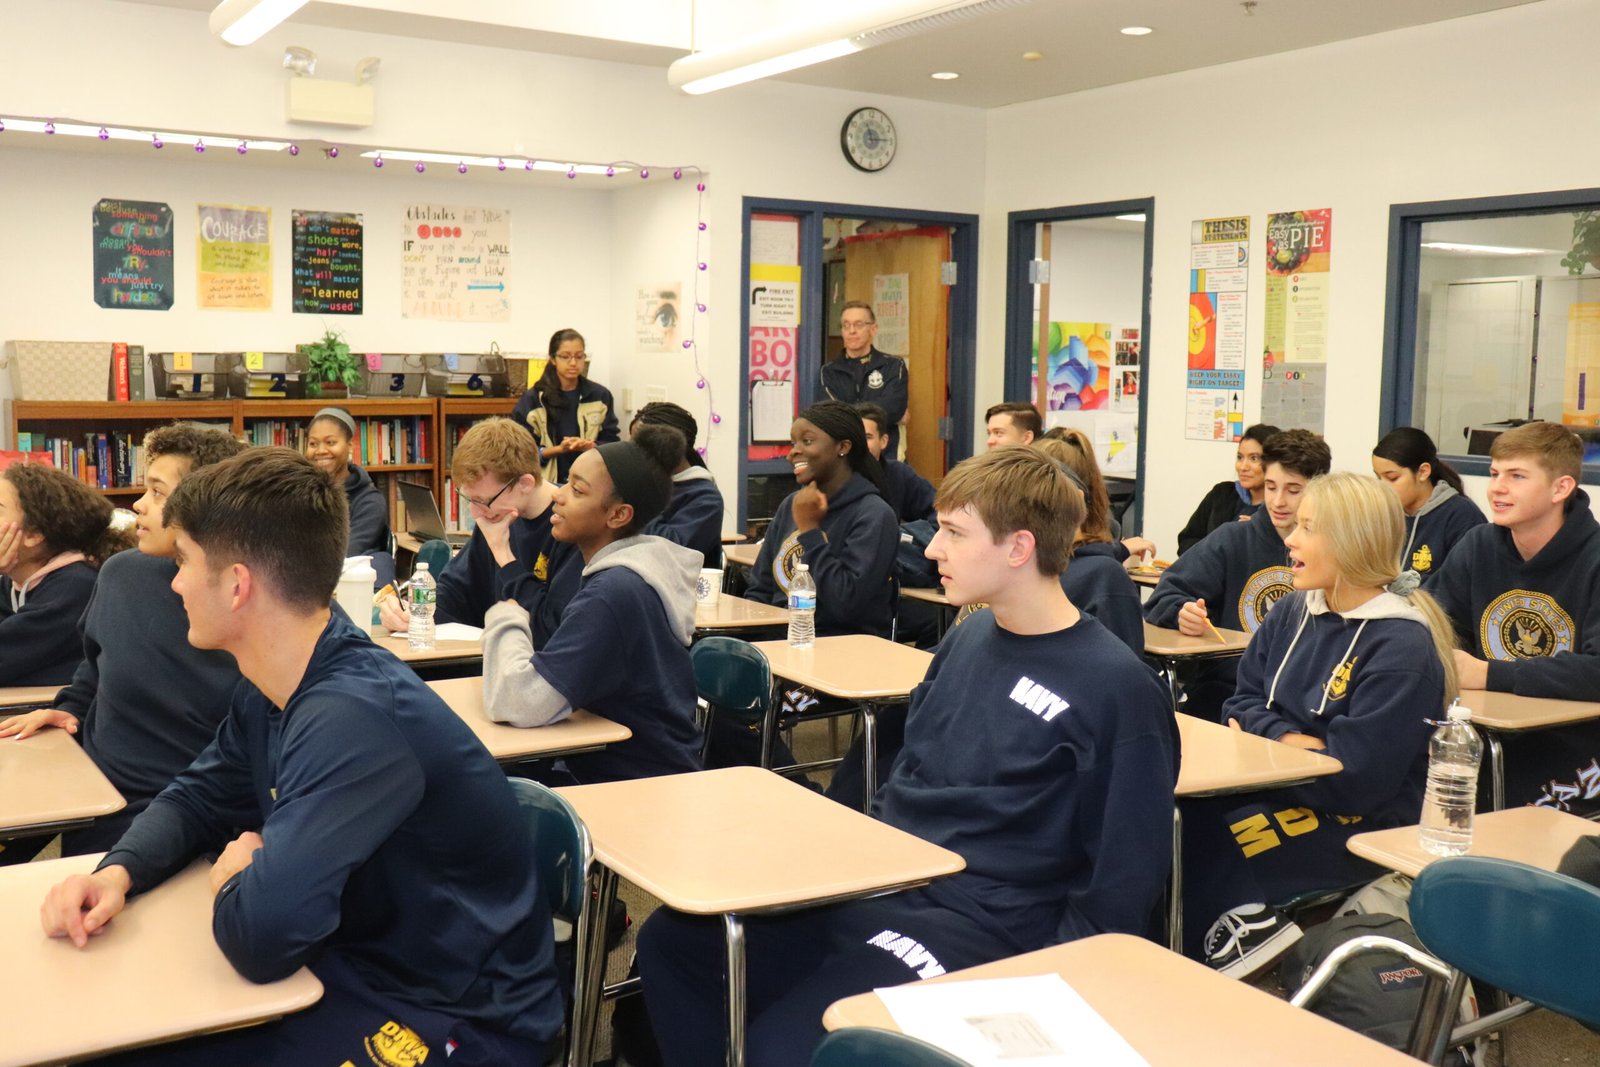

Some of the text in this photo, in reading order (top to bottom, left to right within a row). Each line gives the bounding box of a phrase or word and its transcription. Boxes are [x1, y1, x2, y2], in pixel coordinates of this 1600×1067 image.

[202, 216, 265, 243] COURAGE
[331, 227, 360, 235] matter
[1205, 218, 1247, 234] THESIS
[307, 234, 340, 246] shoes
[1204, 231, 1247, 242] STATEMENTS
[1290, 226, 1324, 249] PIE
[317, 247, 338, 256] hair
[308, 256, 330, 265] jeans
[101, 277, 118, 285] you
[315, 271, 332, 280] will
[313, 286, 359, 299] learned
[304, 299, 319, 307] how
[330, 302, 354, 311] used
[269, 373, 288, 393] 2
[389, 373, 405, 391] 3
[467, 373, 484, 391] 6
[1497, 598, 1566, 632] UNITED STATES
[1009, 676, 1070, 722] NAVY
[866, 930, 946, 980] NAVY
